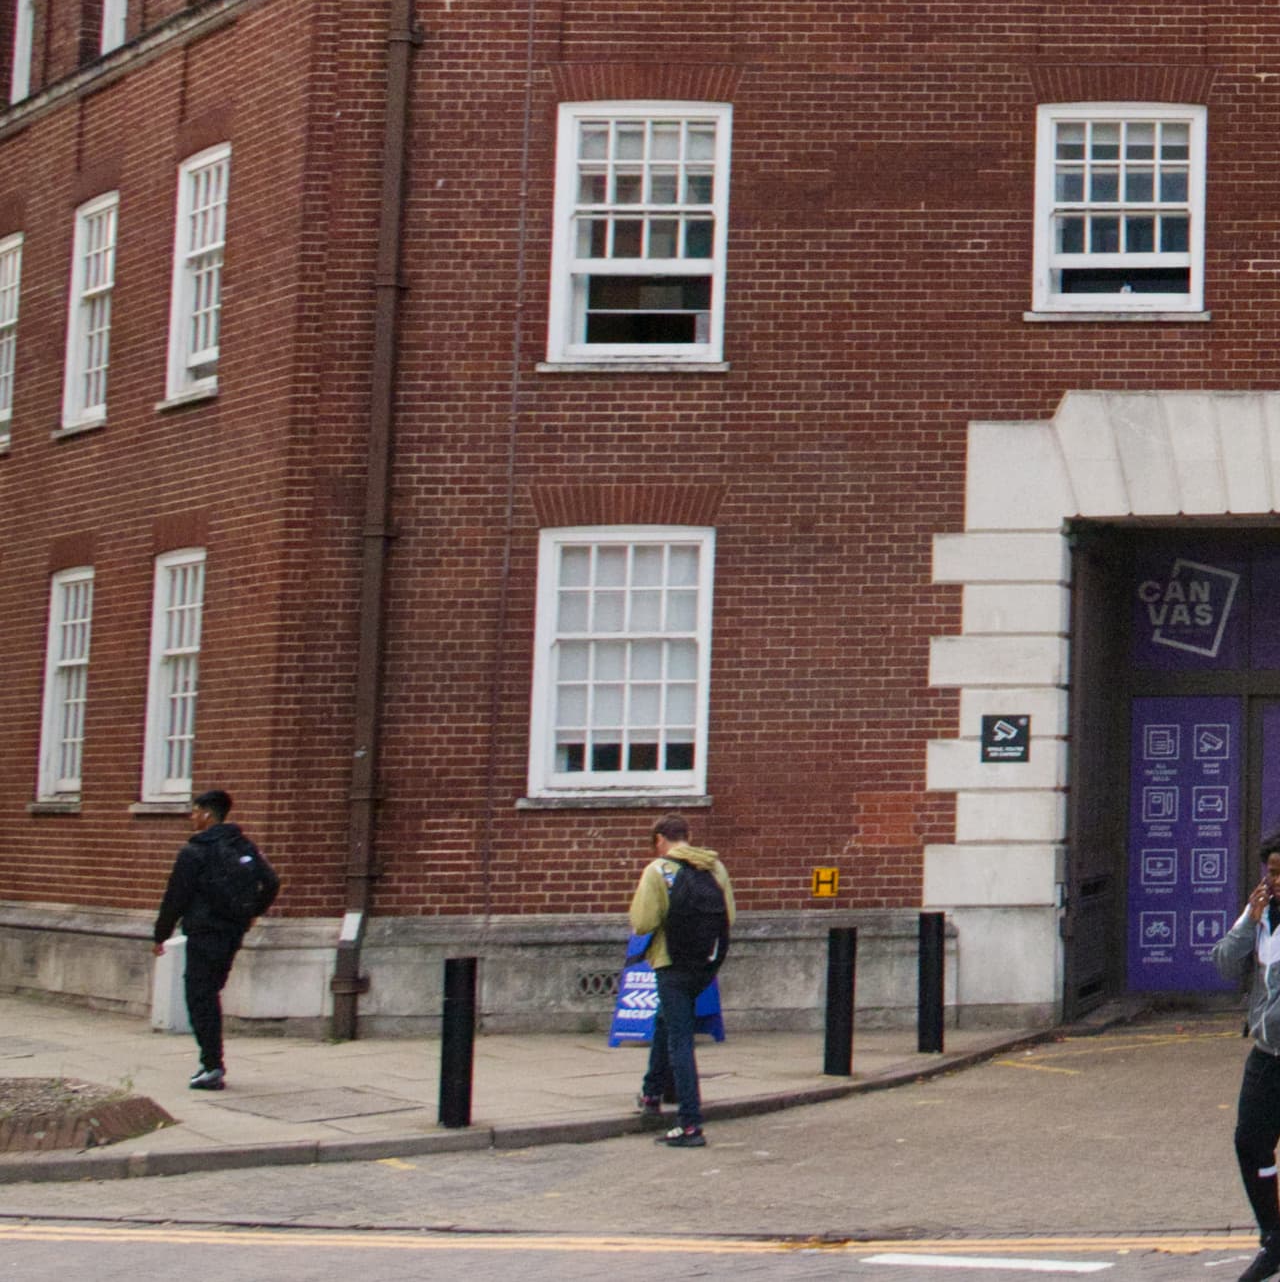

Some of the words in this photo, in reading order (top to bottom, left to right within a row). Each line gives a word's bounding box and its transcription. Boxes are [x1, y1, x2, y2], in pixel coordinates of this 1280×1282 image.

[1139, 580, 1211, 603] CAN
[1148, 603, 1214, 626] VAS
[816, 871, 836, 894] H
